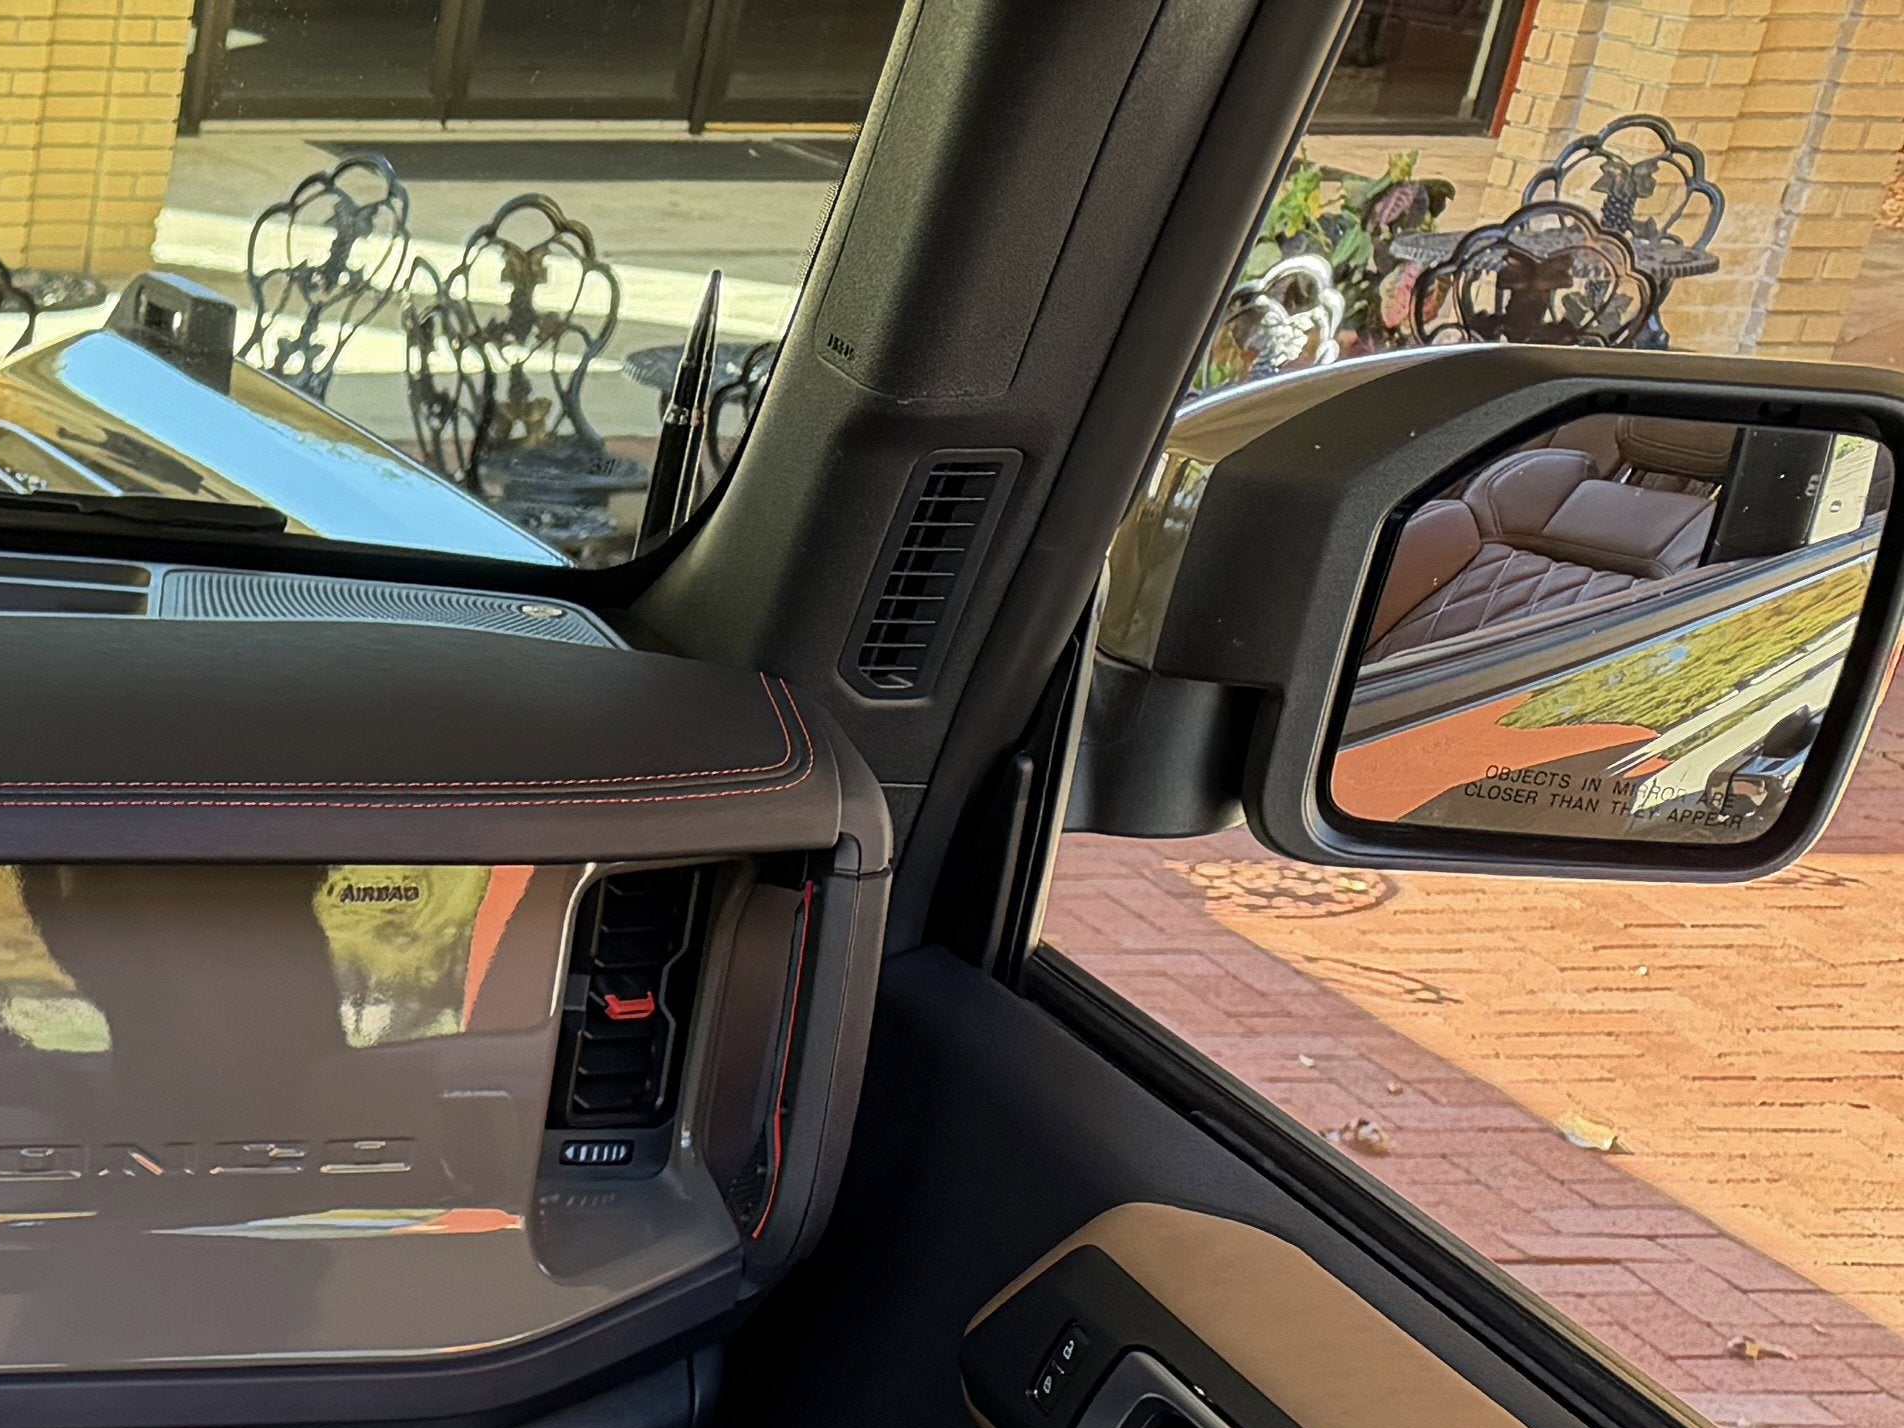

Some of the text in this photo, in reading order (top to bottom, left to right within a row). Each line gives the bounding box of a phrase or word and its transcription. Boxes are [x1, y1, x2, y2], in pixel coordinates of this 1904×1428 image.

[1464, 783, 1743, 830] CLOSER THAN THEY APPEAR
[1486, 764, 1739, 810] OBJECTS IN MIRROR ARE
[340, 883, 420, 903] AIRBAG
